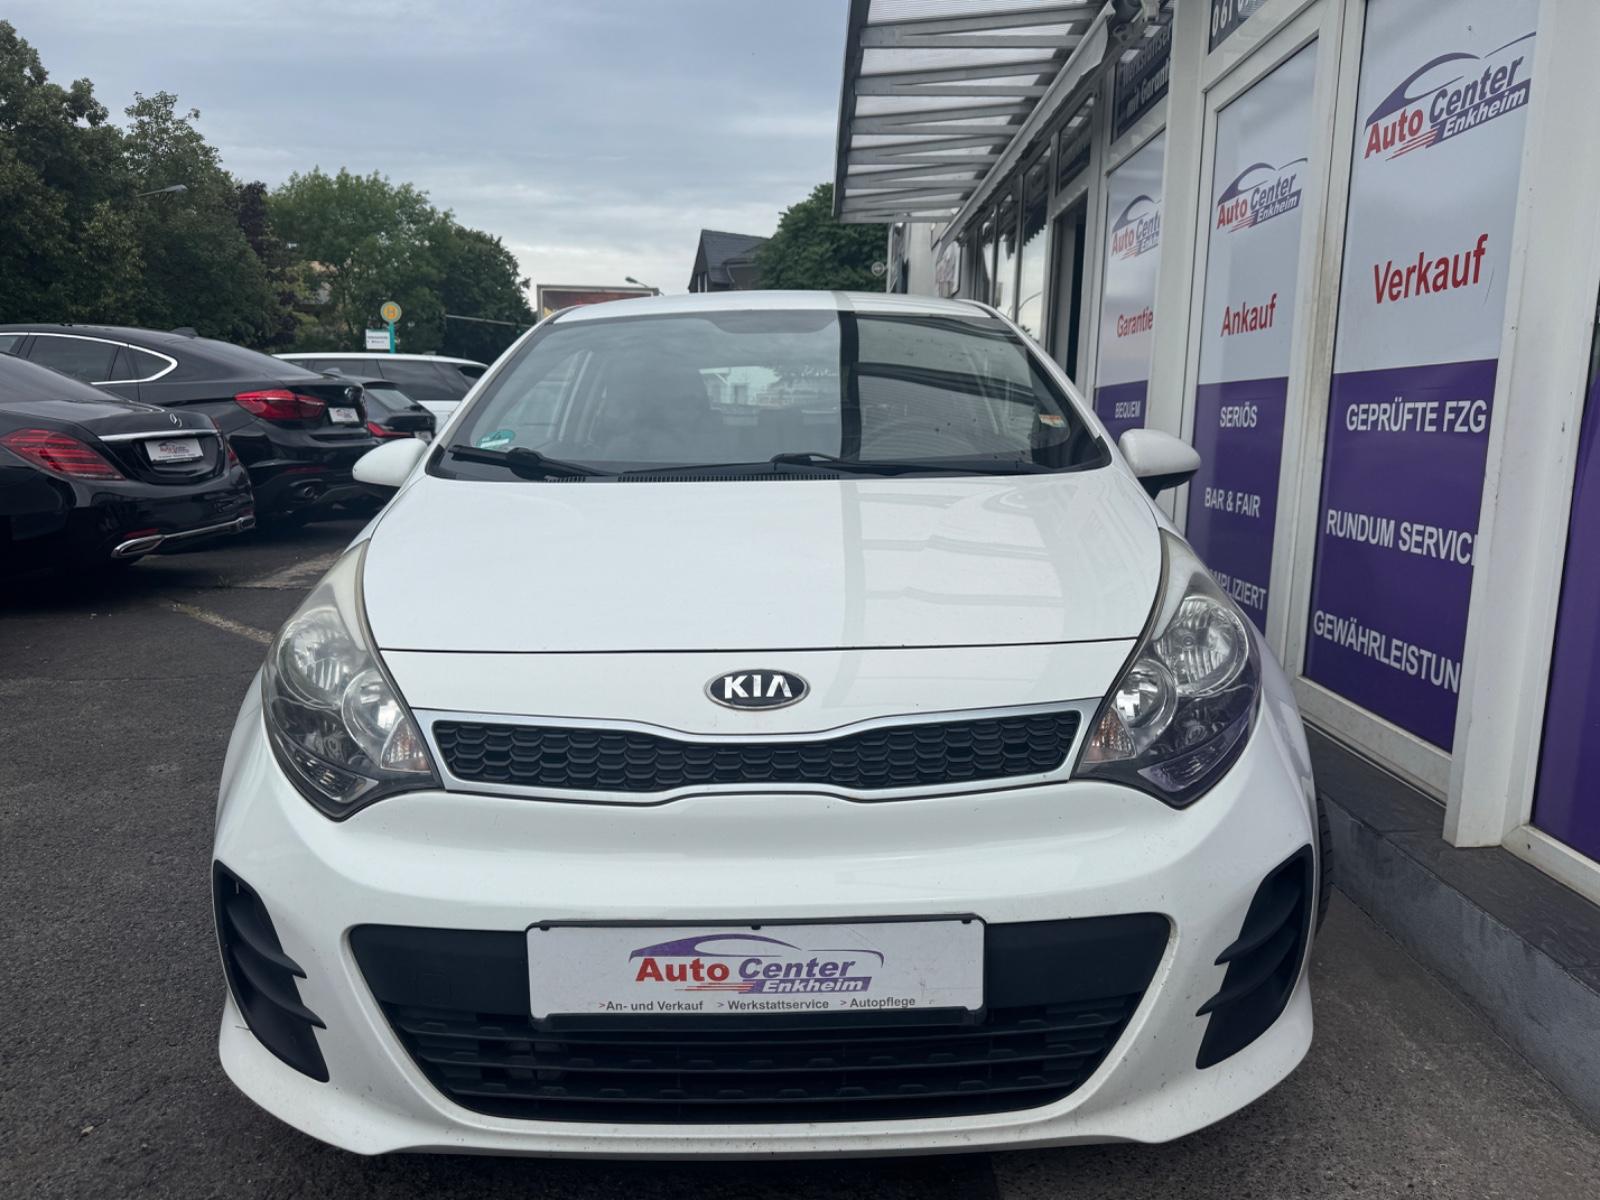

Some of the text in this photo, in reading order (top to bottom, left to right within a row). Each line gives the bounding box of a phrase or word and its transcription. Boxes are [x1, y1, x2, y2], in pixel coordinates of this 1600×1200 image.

[1364, 54, 1524, 160] Auto Center
[1442, 88, 1527, 138] Enkheim
[1216, 174, 1296, 230] Auto Center
[1258, 194, 1298, 221] Enkheim
[1111, 227, 1135, 257] Auto
[1373, 233, 1488, 304] Verkauf
[1117, 307, 1154, 338] Garantie
[1220, 293, 1277, 338] Ankauf
[1115, 400, 1141, 418] BEQUEM
[1219, 401, 1258, 428] SERIÖS
[1346, 396, 1487, 434] GEPRÜFTE FZG
[1204, 486, 1261, 518] BAR & FAIR
[1326, 509, 1478, 567] RUNDUM SERVIC
[1313, 610, 1461, 694] GEWÄHRLEISTUN
[724, 673, 792, 698] KIA
[635, 957, 857, 983] Auto Center
[761, 977, 864, 994] Enkheim
[631, 1000, 654, 1011] und
[657, 1000, 704, 1011] Verkauf
[728, 999, 829, 1011] Werkstattservice
[850, 997, 916, 1009] Autopflege
